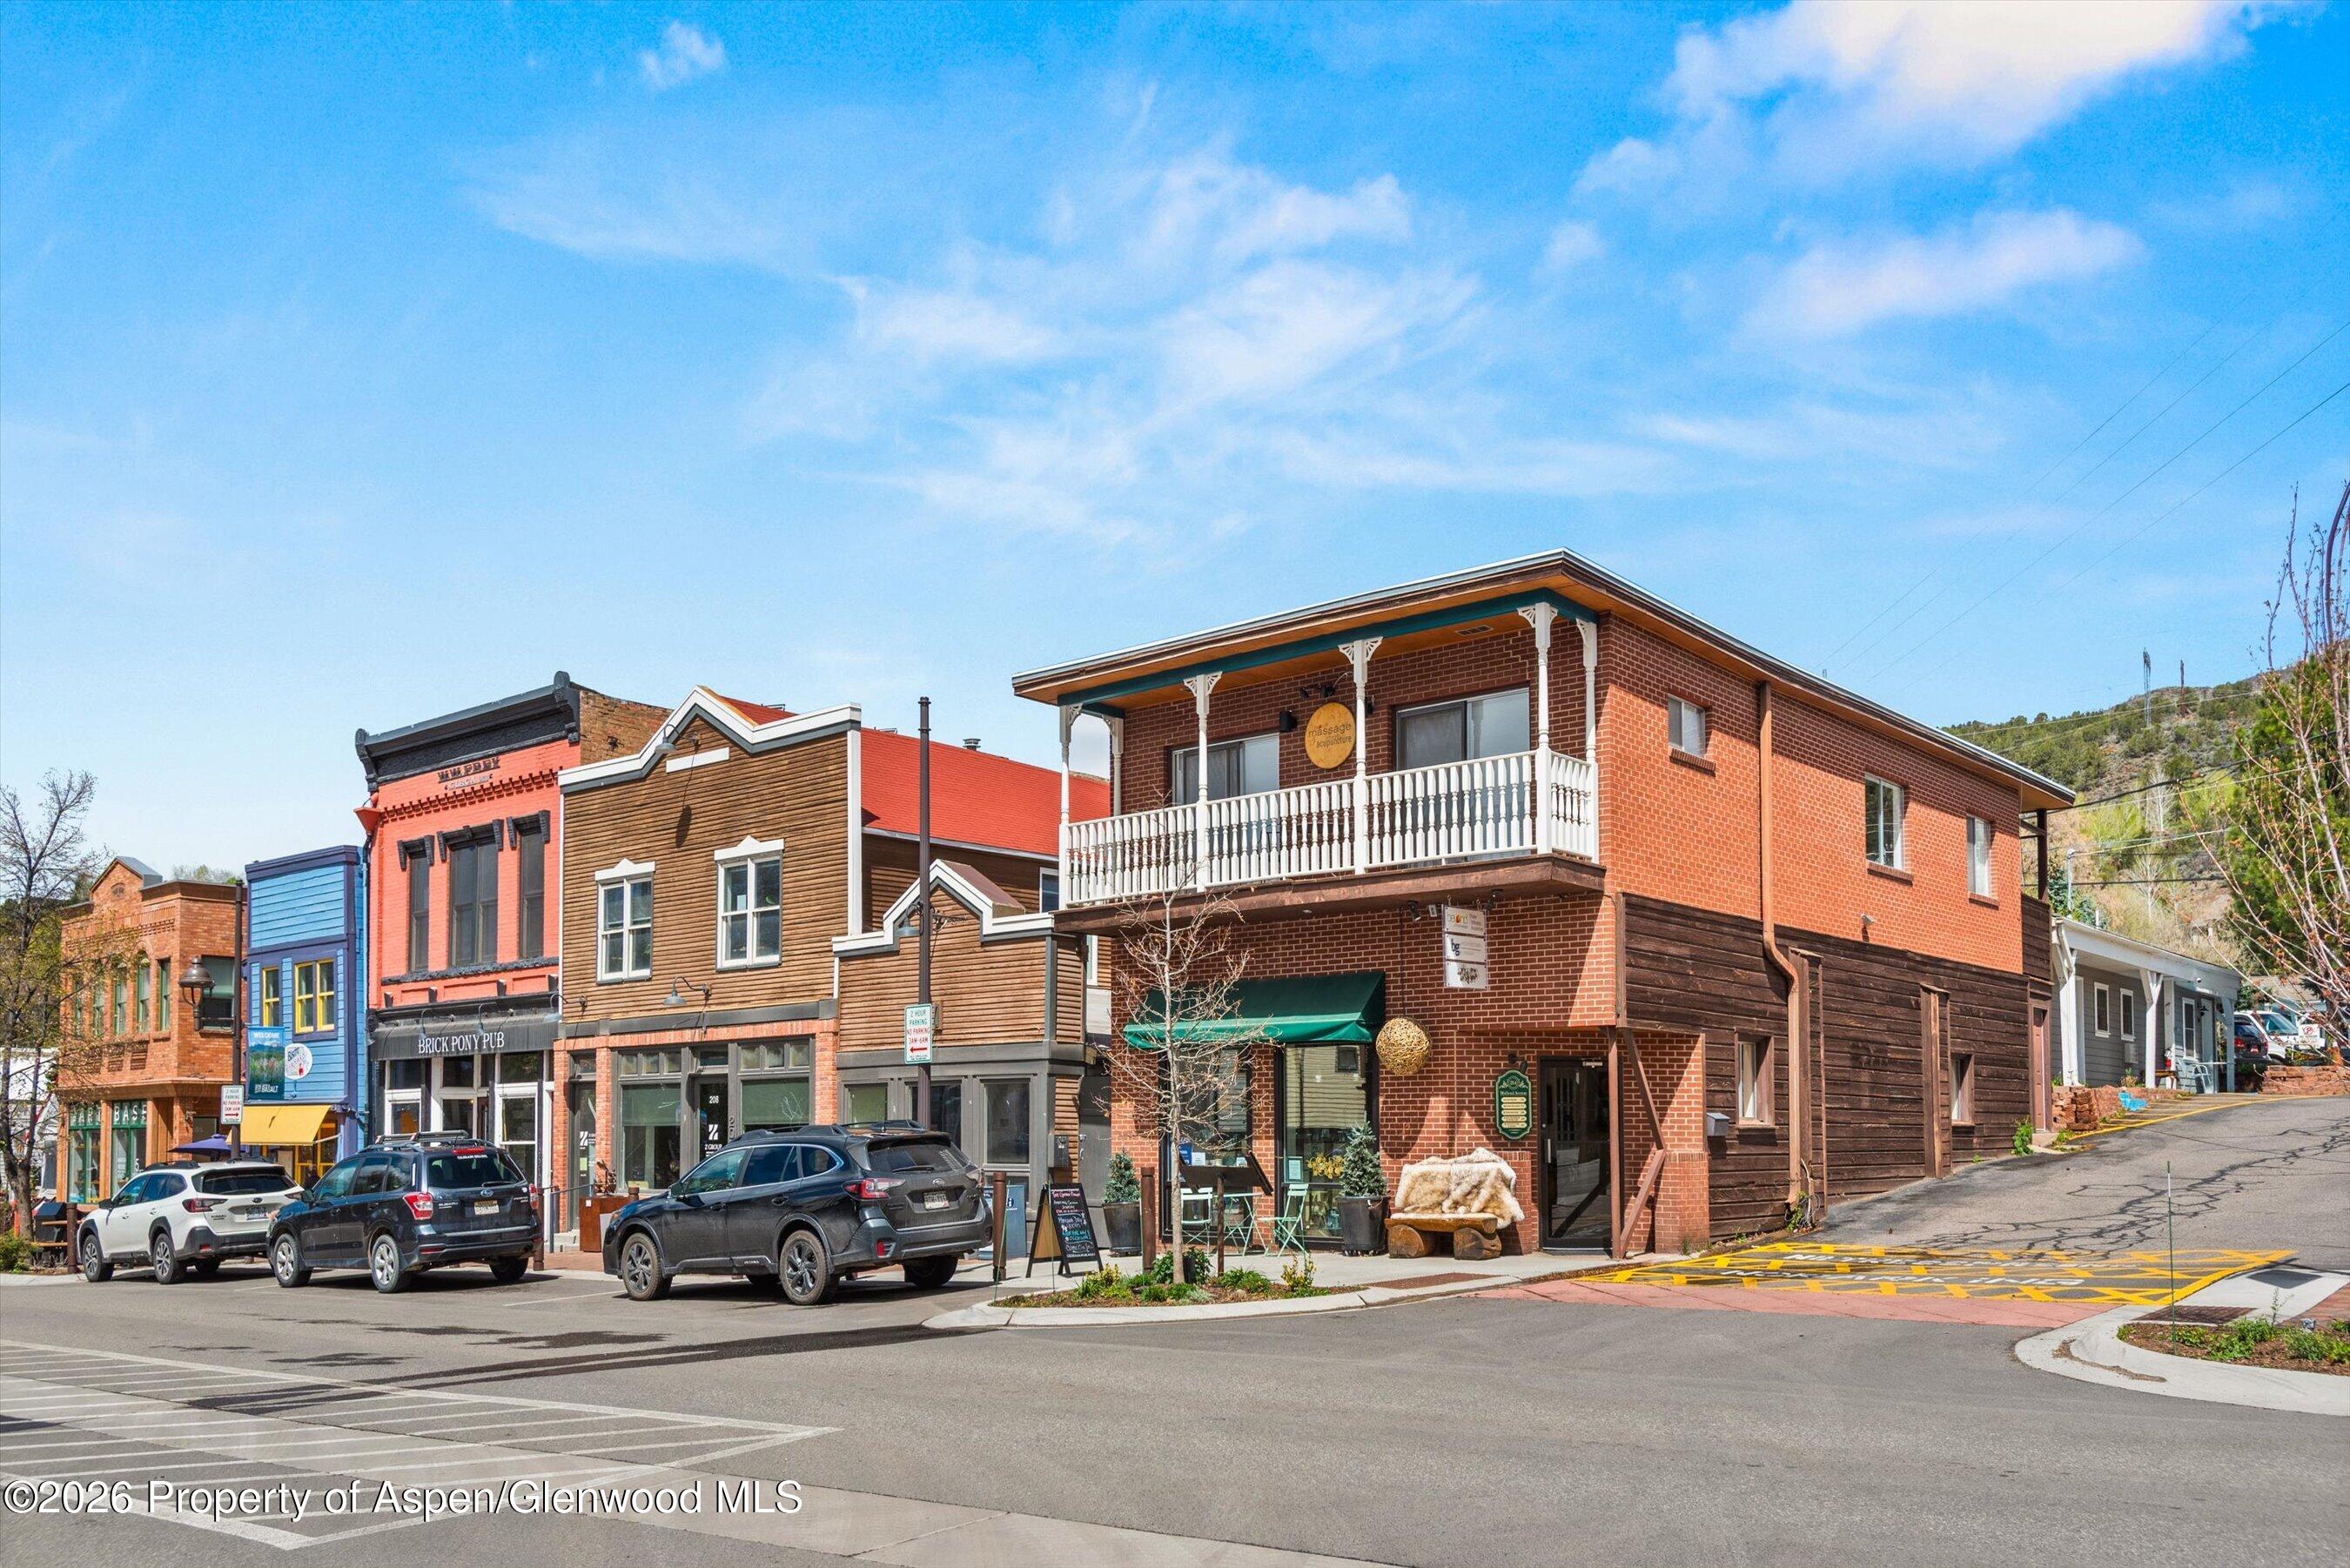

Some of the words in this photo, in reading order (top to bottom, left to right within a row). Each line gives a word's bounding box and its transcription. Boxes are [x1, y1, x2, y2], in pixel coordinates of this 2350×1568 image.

[1308, 723, 1351, 737] massage
[418, 1036, 449, 1054] BRICK
[451, 1034, 480, 1053] PONY
[482, 1031, 505, 1049] PUB
[708, 1096, 720, 1104] 208
[114, 1105, 146, 1121] BASE
[1785, 1272, 2085, 1285] PARKING
